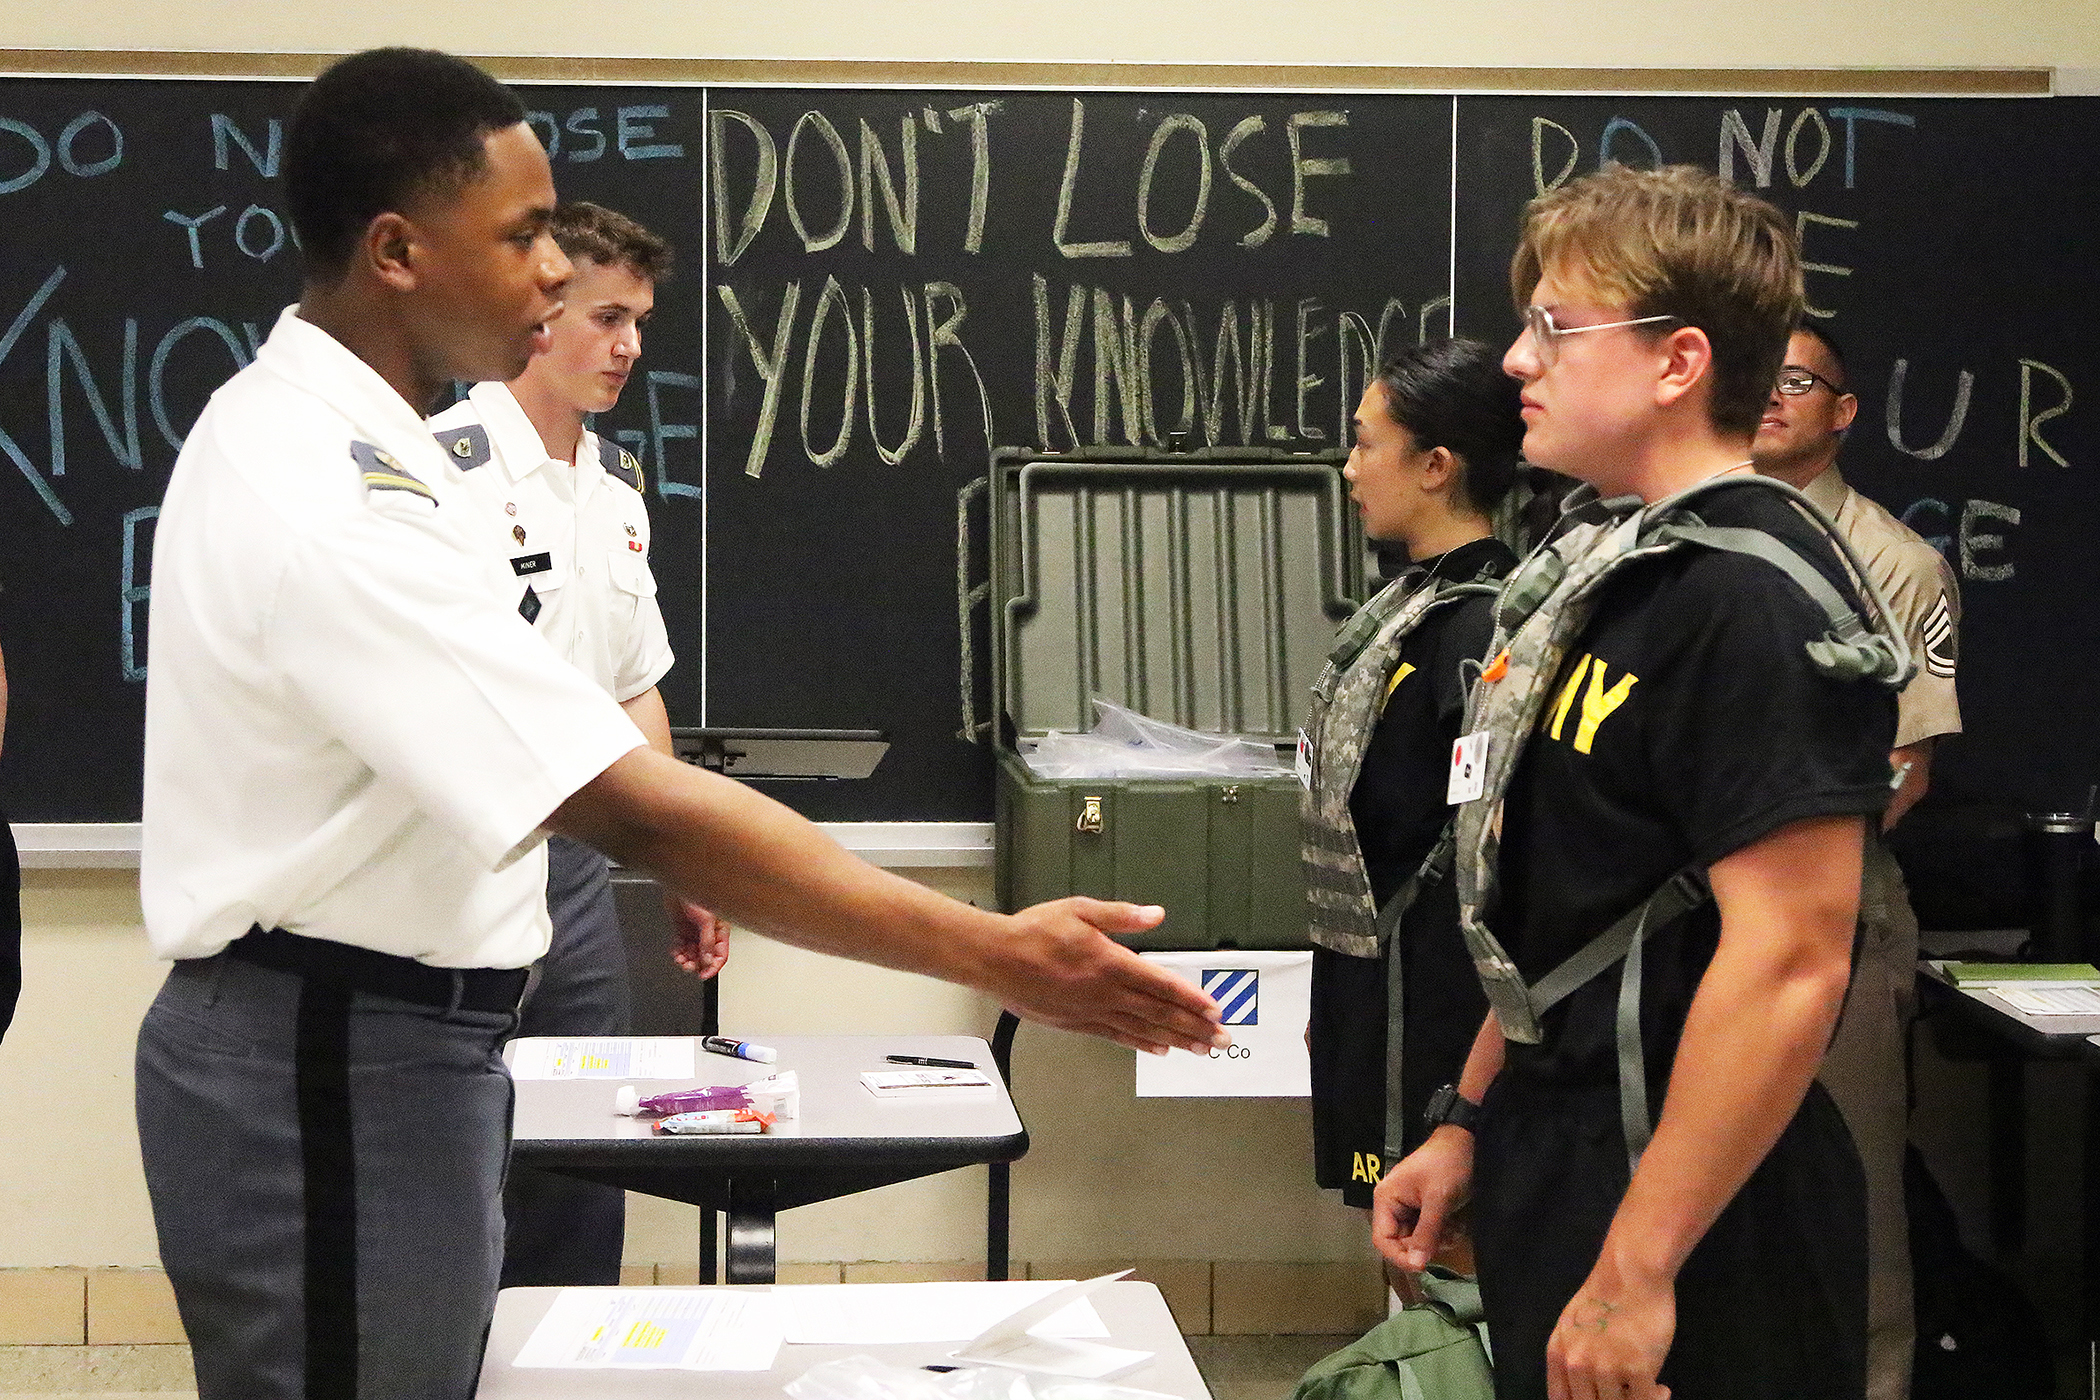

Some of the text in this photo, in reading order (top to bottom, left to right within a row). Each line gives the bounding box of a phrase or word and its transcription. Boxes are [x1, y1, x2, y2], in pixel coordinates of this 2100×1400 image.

[525, 104, 685, 163] OSE
[1718, 106, 1916, 189] NOT
[709, 98, 1351, 266] DON'T LOSE
[717, 274, 993, 479] YOUR
[520, 561, 537, 570] MINER
[1227, 1044, 1251, 1059] Co
[1352, 1151, 1382, 1184] AR
